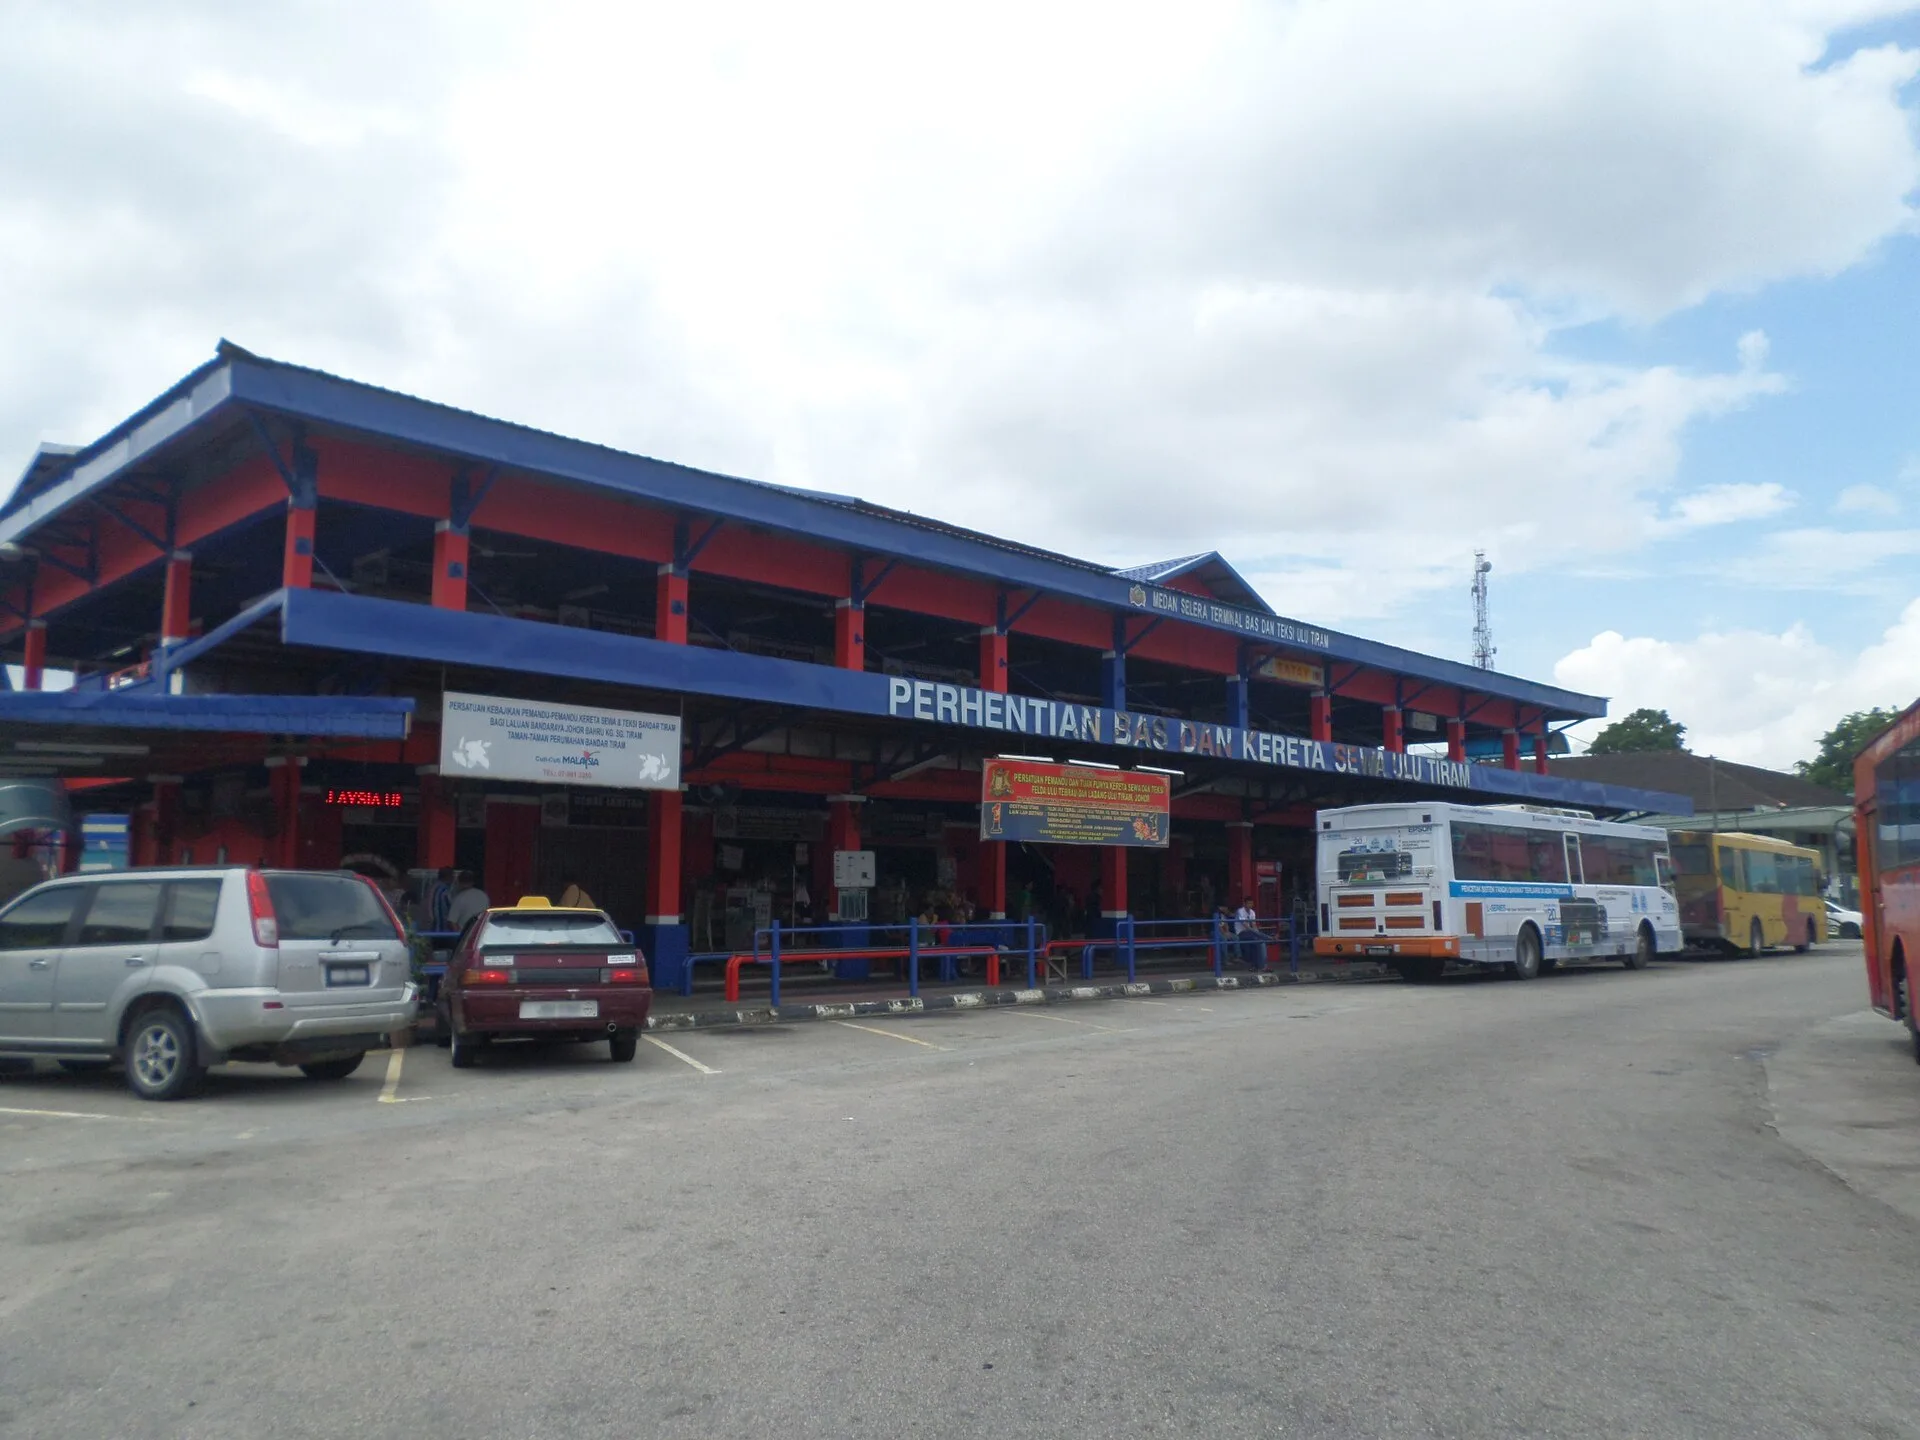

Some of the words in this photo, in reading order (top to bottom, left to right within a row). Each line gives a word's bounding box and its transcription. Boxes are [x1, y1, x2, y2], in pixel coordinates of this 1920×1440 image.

[1153, 591, 1178, 612] MEDAN
[1181, 598, 1208, 620] SELERA
[1210, 606, 1243, 628] TERMINAL
[1245, 616, 1259, 632] BAS
[1262, 619, 1275, 636] DAN
[1277, 623, 1295, 640] TEKSI
[1297, 628, 1309, 644] ULU
[1311, 631, 1329, 649] TIRAM
[449, 701, 486, 712] PERSATUAN
[487, 705, 521, 716] KEBAJIKAN
[522, 708, 578, 721] PEMANDU-PEMANDU
[578, 715, 600, 724] KERETA
[601, 717, 617, 726] SEWA
[622, 720, 638, 729] TEKSI
[638, 721, 660, 730] BANDAR
[660, 723, 676, 732] TIRAM
[490, 717, 505, 726] BAGI
[506, 719, 530, 729] LALUAN
[531, 722, 564, 732] BANDARAYA
[565, 726, 584, 735] JOHOR
[585, 727, 605, 736] BAHRU
[626, 731, 642, 739] TIRAM
[889, 677, 1101, 743] PERHENTIAN
[1114, 711, 1169, 750] BAS
[1180, 722, 1233, 759] DAN
[1242, 730, 1326, 769] KERETA
[1335, 744, 1388, 779] SEWA
[1392, 753, 1422, 782] ULU
[1427, 760, 1471, 789] TIRAM
[508, 731, 549, 743] TAMAN-TAMAN
[550, 735, 584, 746] PERUMAHAN
[585, 738, 608, 748] BANDAR
[609, 740, 626, 749] TIRAM
[562, 756, 599, 769] MALAYSIA
[1014, 773, 1044, 783] PERSATUAN
[1044, 776, 1068, 786] PEMANDU
[1110, 782, 1127, 791] KERETA
[1032, 785, 1047, 795] FELDA
